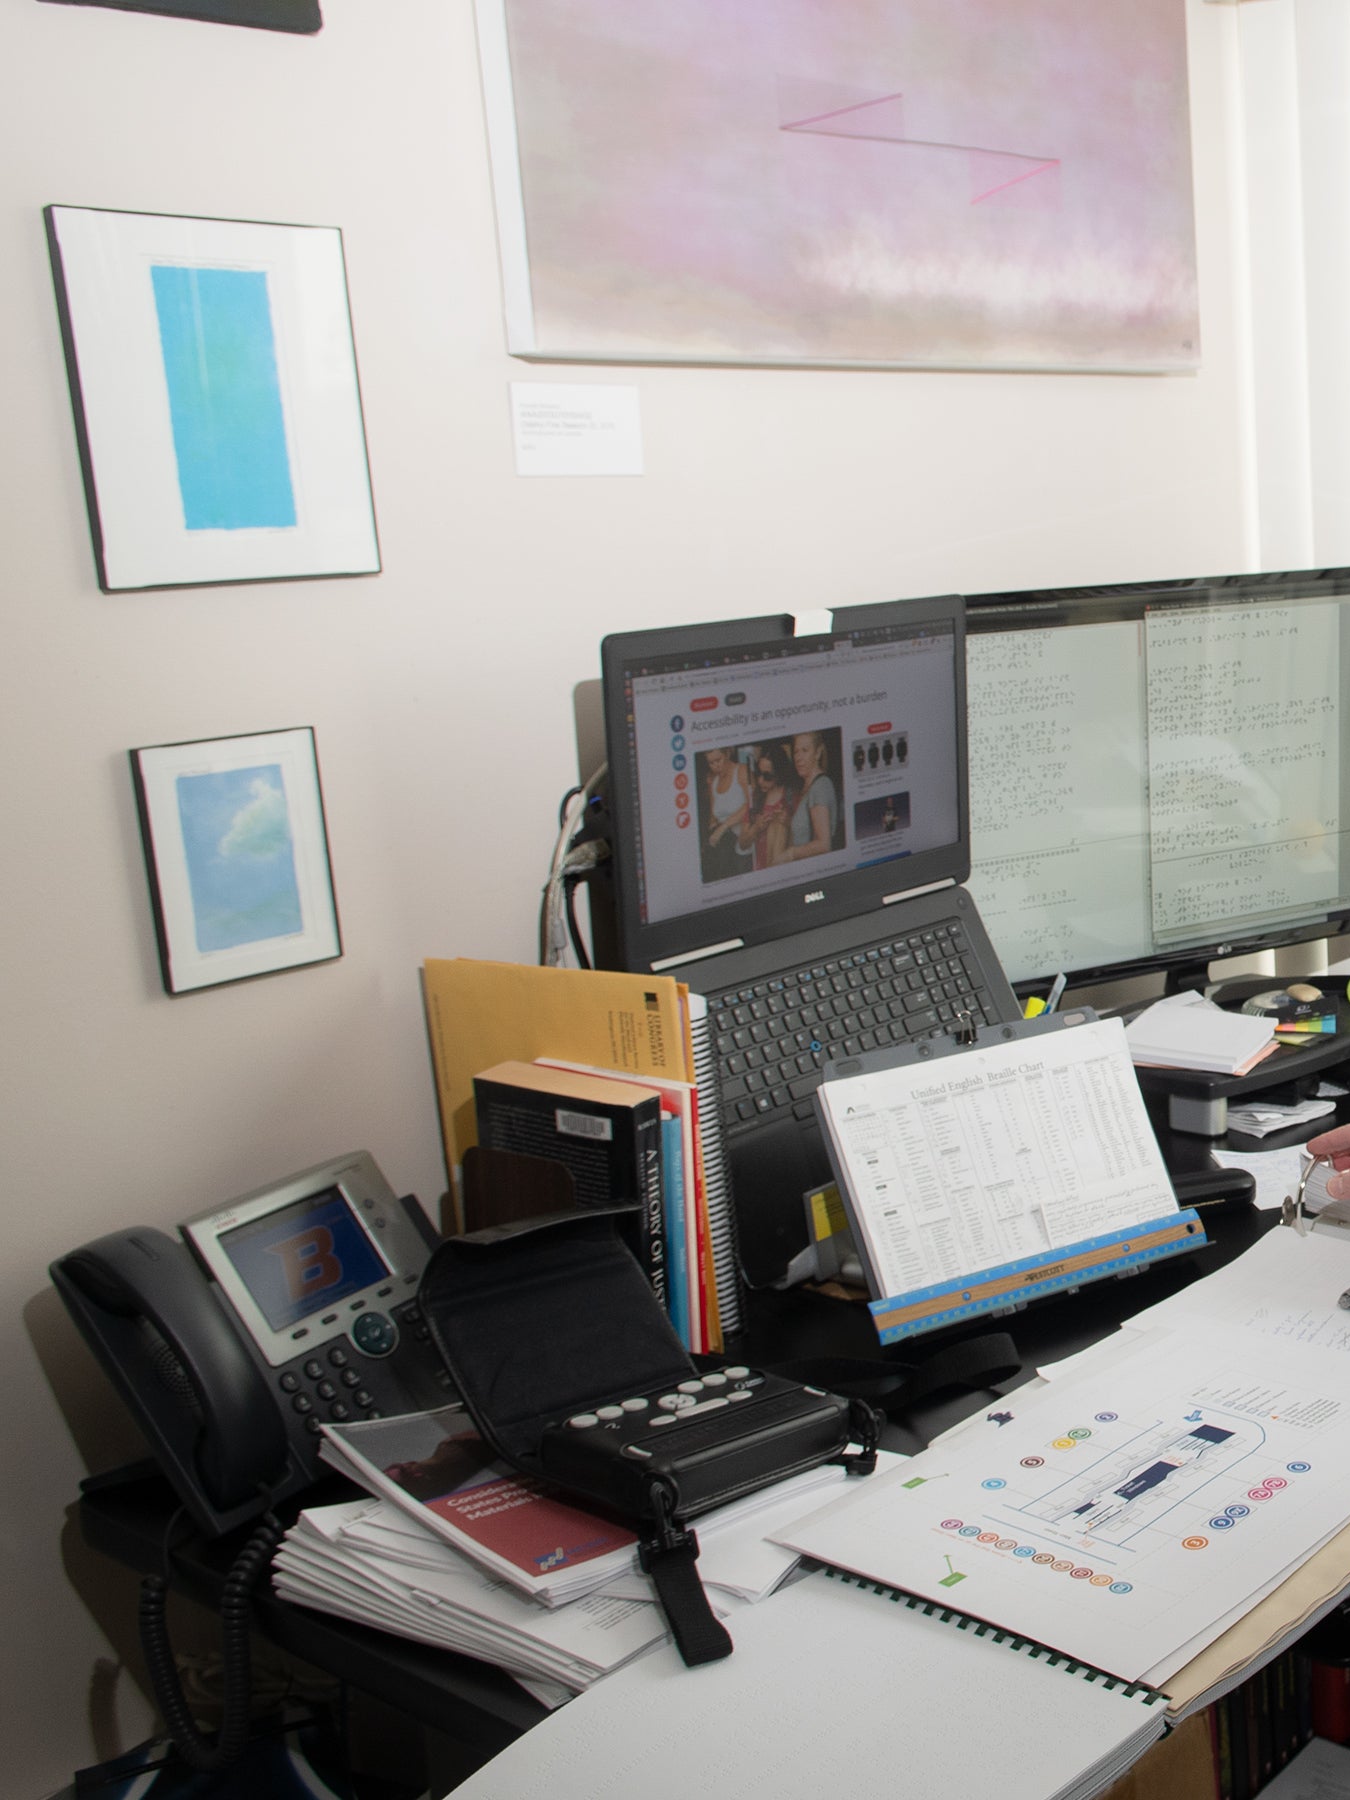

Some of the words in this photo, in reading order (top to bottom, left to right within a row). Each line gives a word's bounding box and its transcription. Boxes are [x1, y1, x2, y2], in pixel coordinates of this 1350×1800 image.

[691, 711, 749, 731] Accessibility
[751, 711, 760, 722] is
[761, 709, 773, 720] an
[775, 702, 829, 719] opportunity,
[856, 690, 888, 705] burden
[648, 1013, 658, 1066] CONGRESS
[910, 1083, 946, 1100] Unified
[948, 1075, 983, 1092] English
[986, 1067, 1017, 1082] Braille
[1018, 1061, 1045, 1075] Chart
[646, 1150, 658, 1162] A
[647, 1163, 662, 1235] THEORY
[264, 1225, 342, 1300] B
[651, 1240, 664, 1262] OF
